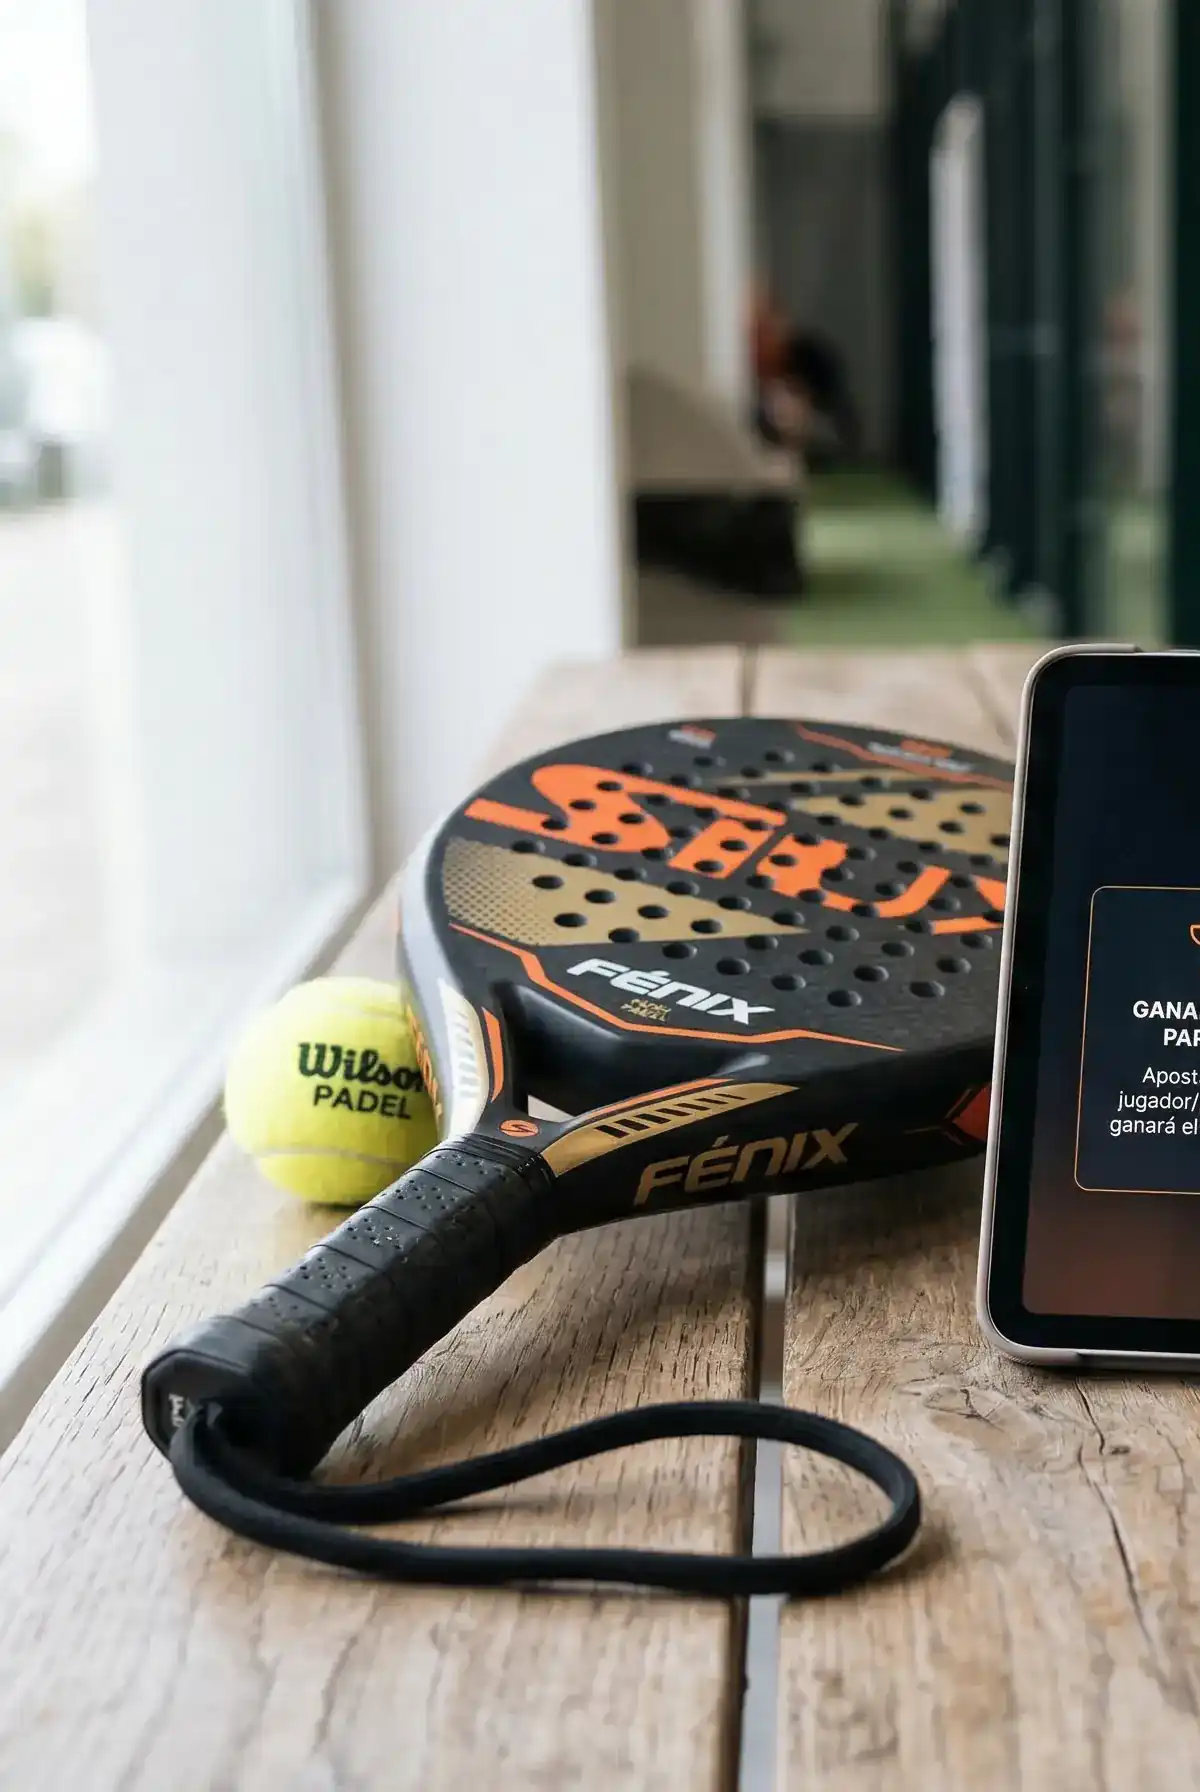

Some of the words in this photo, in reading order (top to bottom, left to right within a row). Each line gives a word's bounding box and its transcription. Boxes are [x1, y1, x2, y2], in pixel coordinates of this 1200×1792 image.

[566, 958, 776, 1025] FÉNIX
[314, 1085, 412, 1120] PADEL
[1109, 1116, 1176, 1137] ganará
[1180, 1117, 1199, 1136] el
[634, 1122, 858, 1206] FÉNIX
